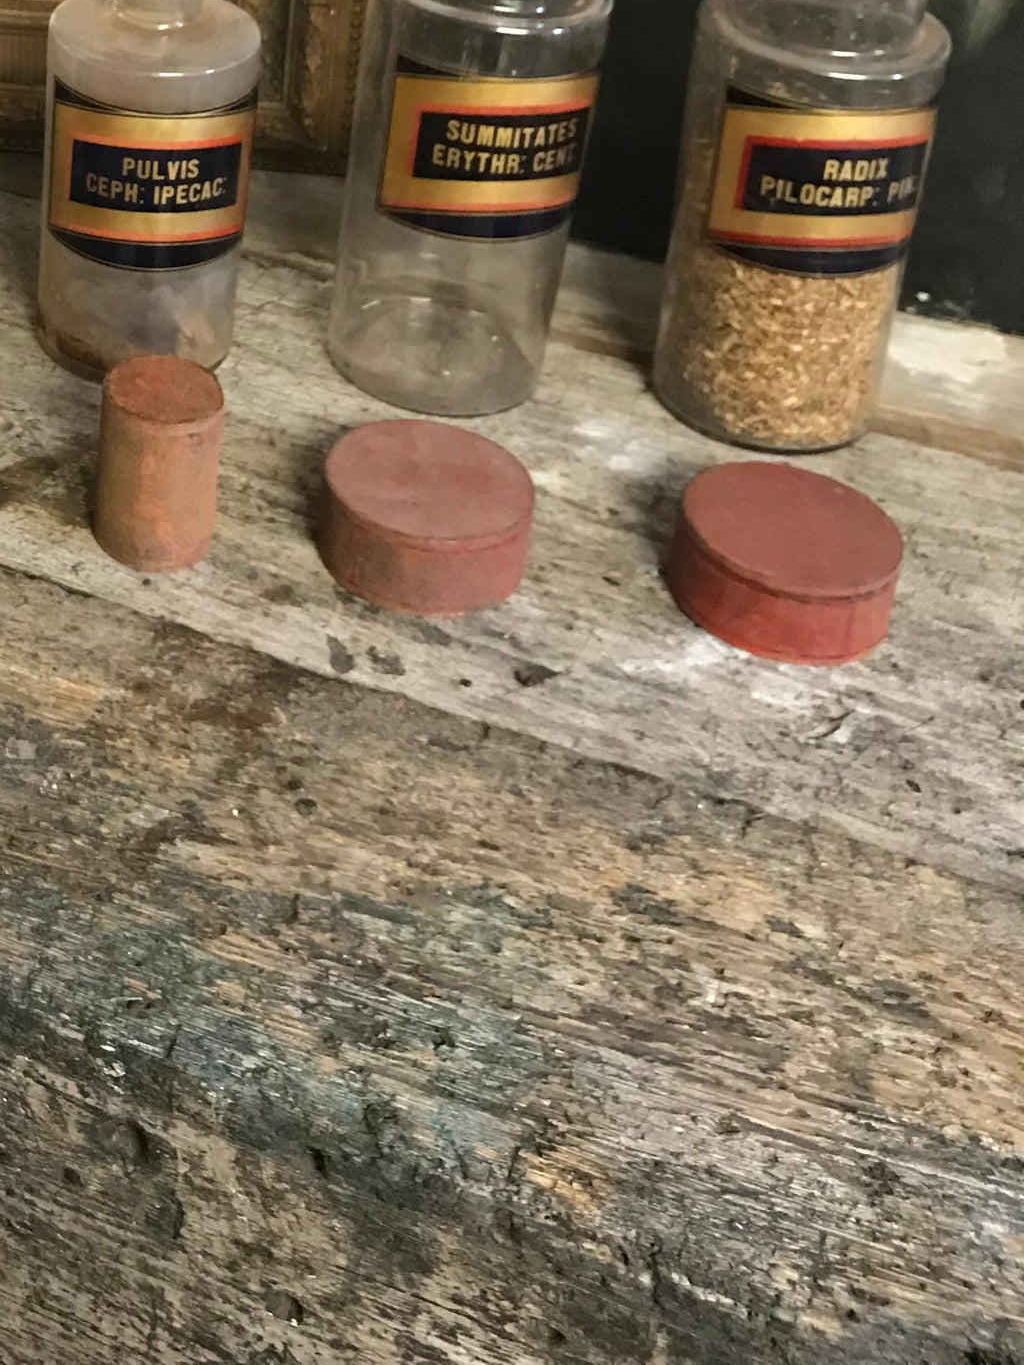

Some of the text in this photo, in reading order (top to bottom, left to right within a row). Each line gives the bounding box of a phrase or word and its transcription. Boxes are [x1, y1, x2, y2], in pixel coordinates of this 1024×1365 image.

[446, 118, 577, 148] SUMMITATES
[122, 157, 200, 180] PULVIS
[432, 143, 526, 175] ERYTHR:
[823, 157, 889, 181] RADIX
[86, 172, 145, 204] CEPH:
[760, 175, 880, 208] PILOCARP:
